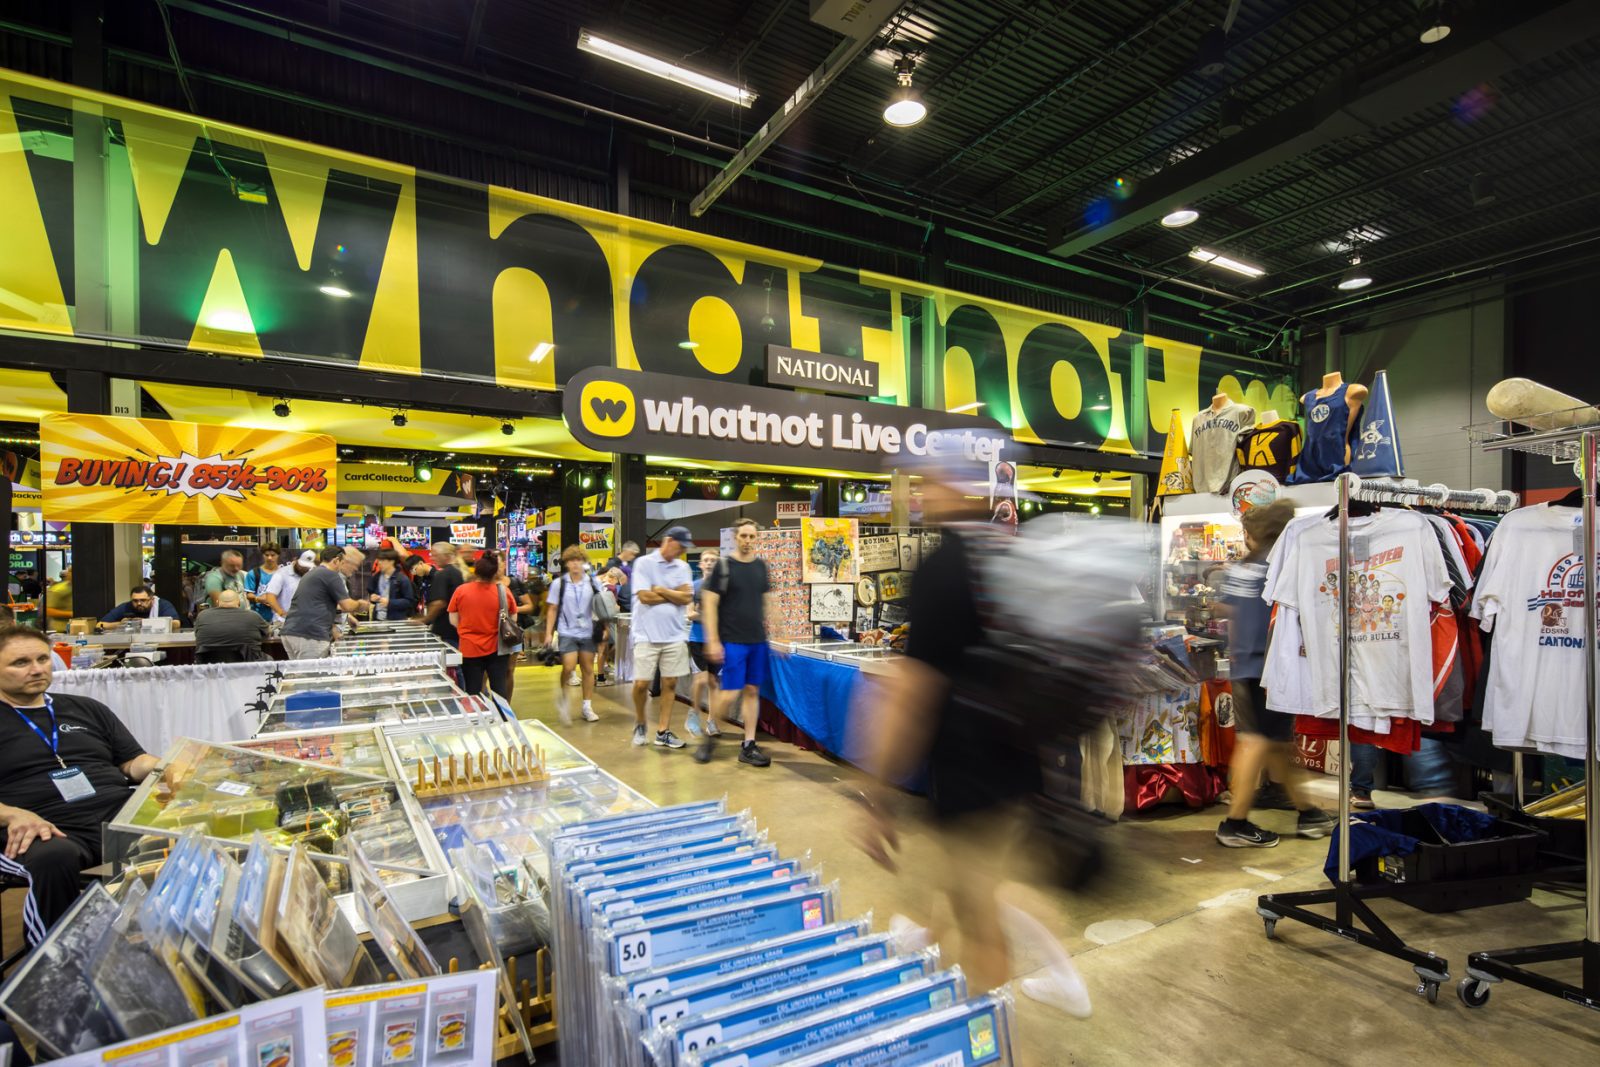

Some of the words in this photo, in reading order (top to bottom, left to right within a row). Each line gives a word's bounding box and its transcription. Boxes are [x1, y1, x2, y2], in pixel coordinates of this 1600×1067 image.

[777, 356, 873, 387] NATIONAL
[643, 397, 823, 447] whatnot
[832, 413, 900, 453] Live
[905, 424, 1004, 462] Center
[1249, 432, 1280, 467] K
[54, 458, 187, 488] BUYING!
[188, 464, 327, 492] 85%-90%
[778, 503, 796, 512] FIRE
[622, 941, 646, 961] 5.0
[733, 954, 764, 966] UNIVERSAL
[765, 949, 784, 959] GRADE
[755, 971, 788, 986] UNIVERSAL
[789, 965, 808, 976] GRADE
[790, 993, 823, 1009] UNIVERSAL
[824, 987, 844, 998] GRADE
[819, 1019, 852, 1036] UNIVERSAL
[854, 1012, 875, 1023] GRADE
